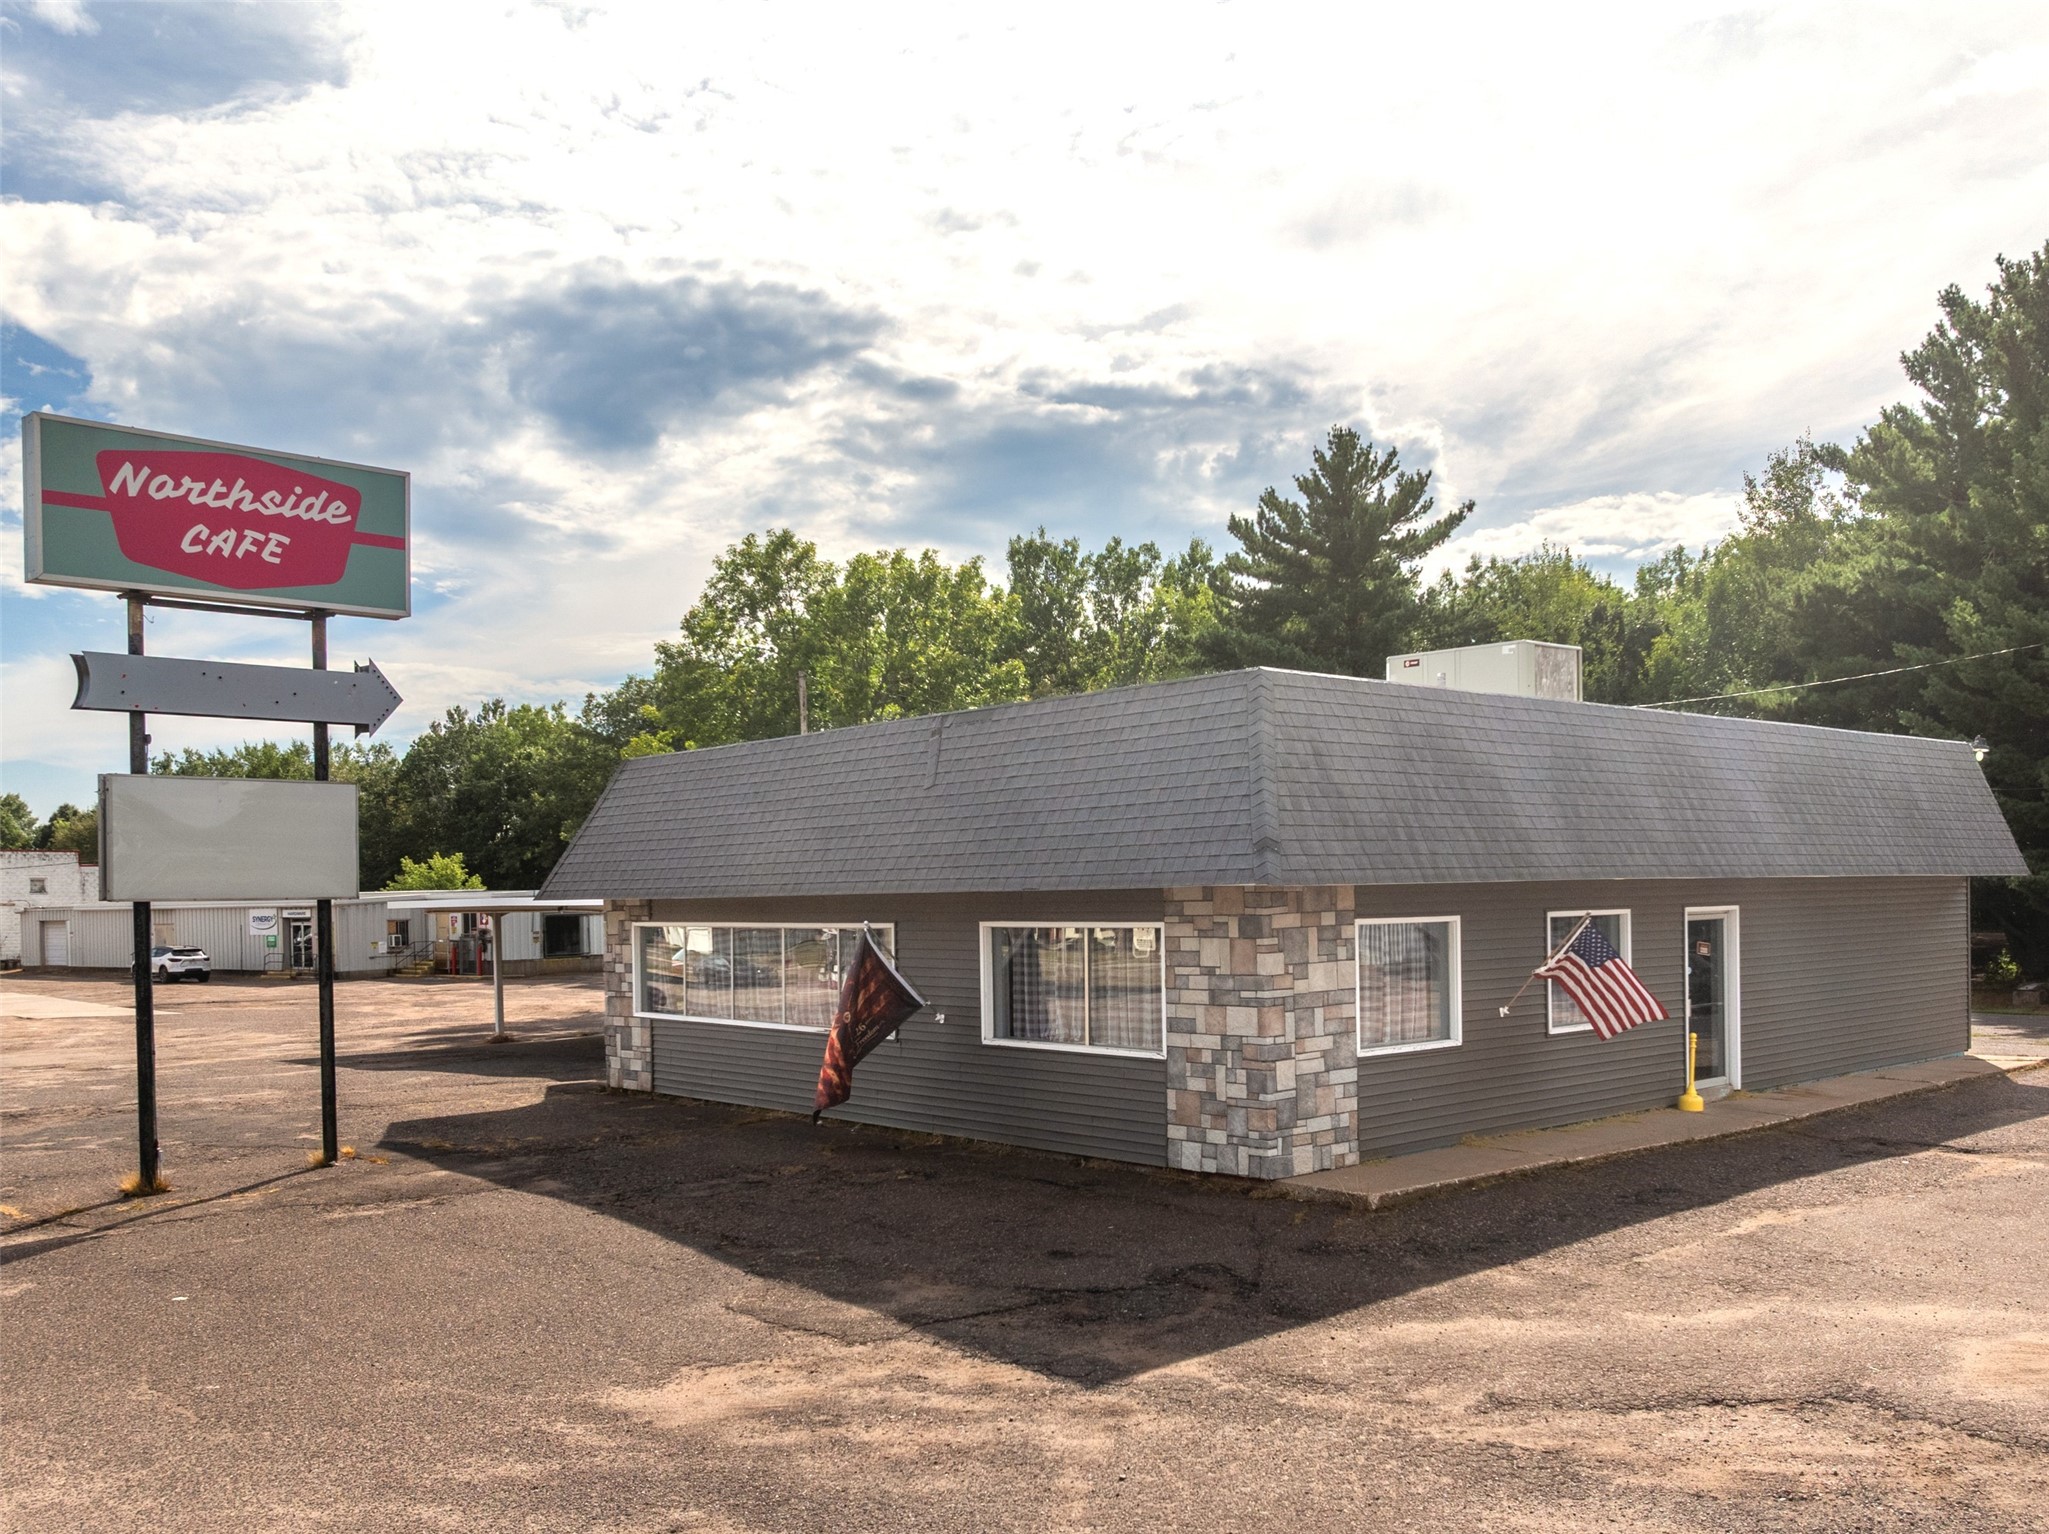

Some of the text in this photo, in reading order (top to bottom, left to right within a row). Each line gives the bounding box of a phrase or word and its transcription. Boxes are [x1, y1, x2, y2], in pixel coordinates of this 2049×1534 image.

[109, 461, 352, 525] Northside
[180, 523, 291, 565] CAFE
[252, 915, 273, 923] SYNERGY
